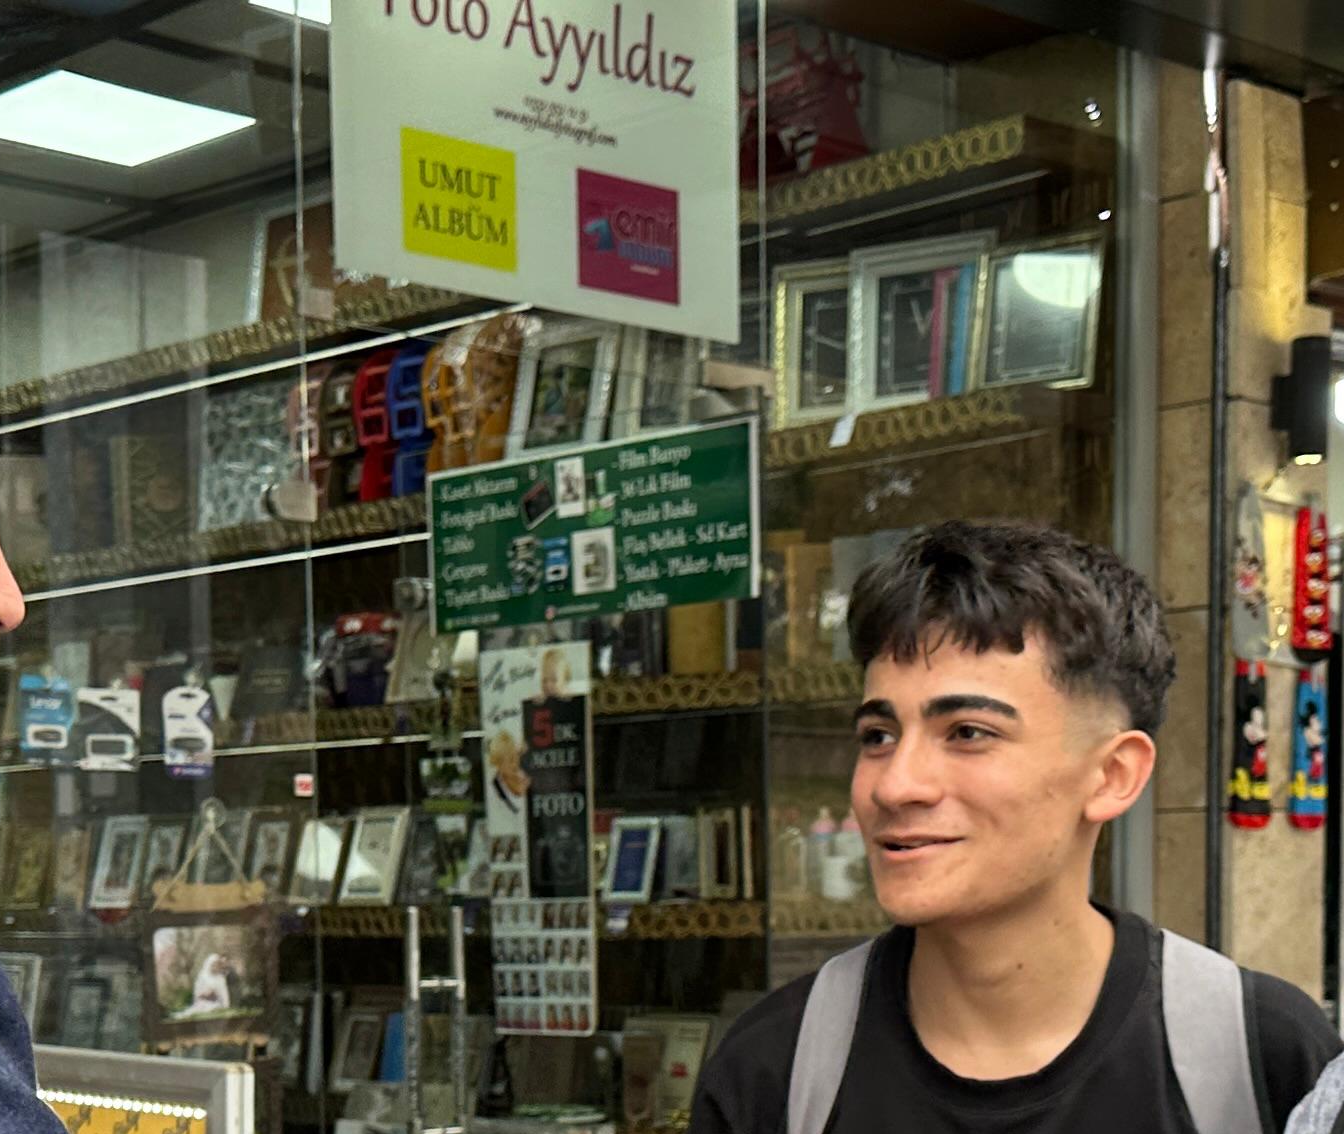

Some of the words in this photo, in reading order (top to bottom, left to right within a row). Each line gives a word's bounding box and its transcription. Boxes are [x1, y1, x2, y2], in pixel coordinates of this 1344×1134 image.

[384, 0, 490, 40] oto
[504, 0, 696, 97] Ayyıldız
[418, 157, 501, 201] UMUT
[413, 202, 508, 247] ALBÜM
[533, 792, 585, 817] FOTO
